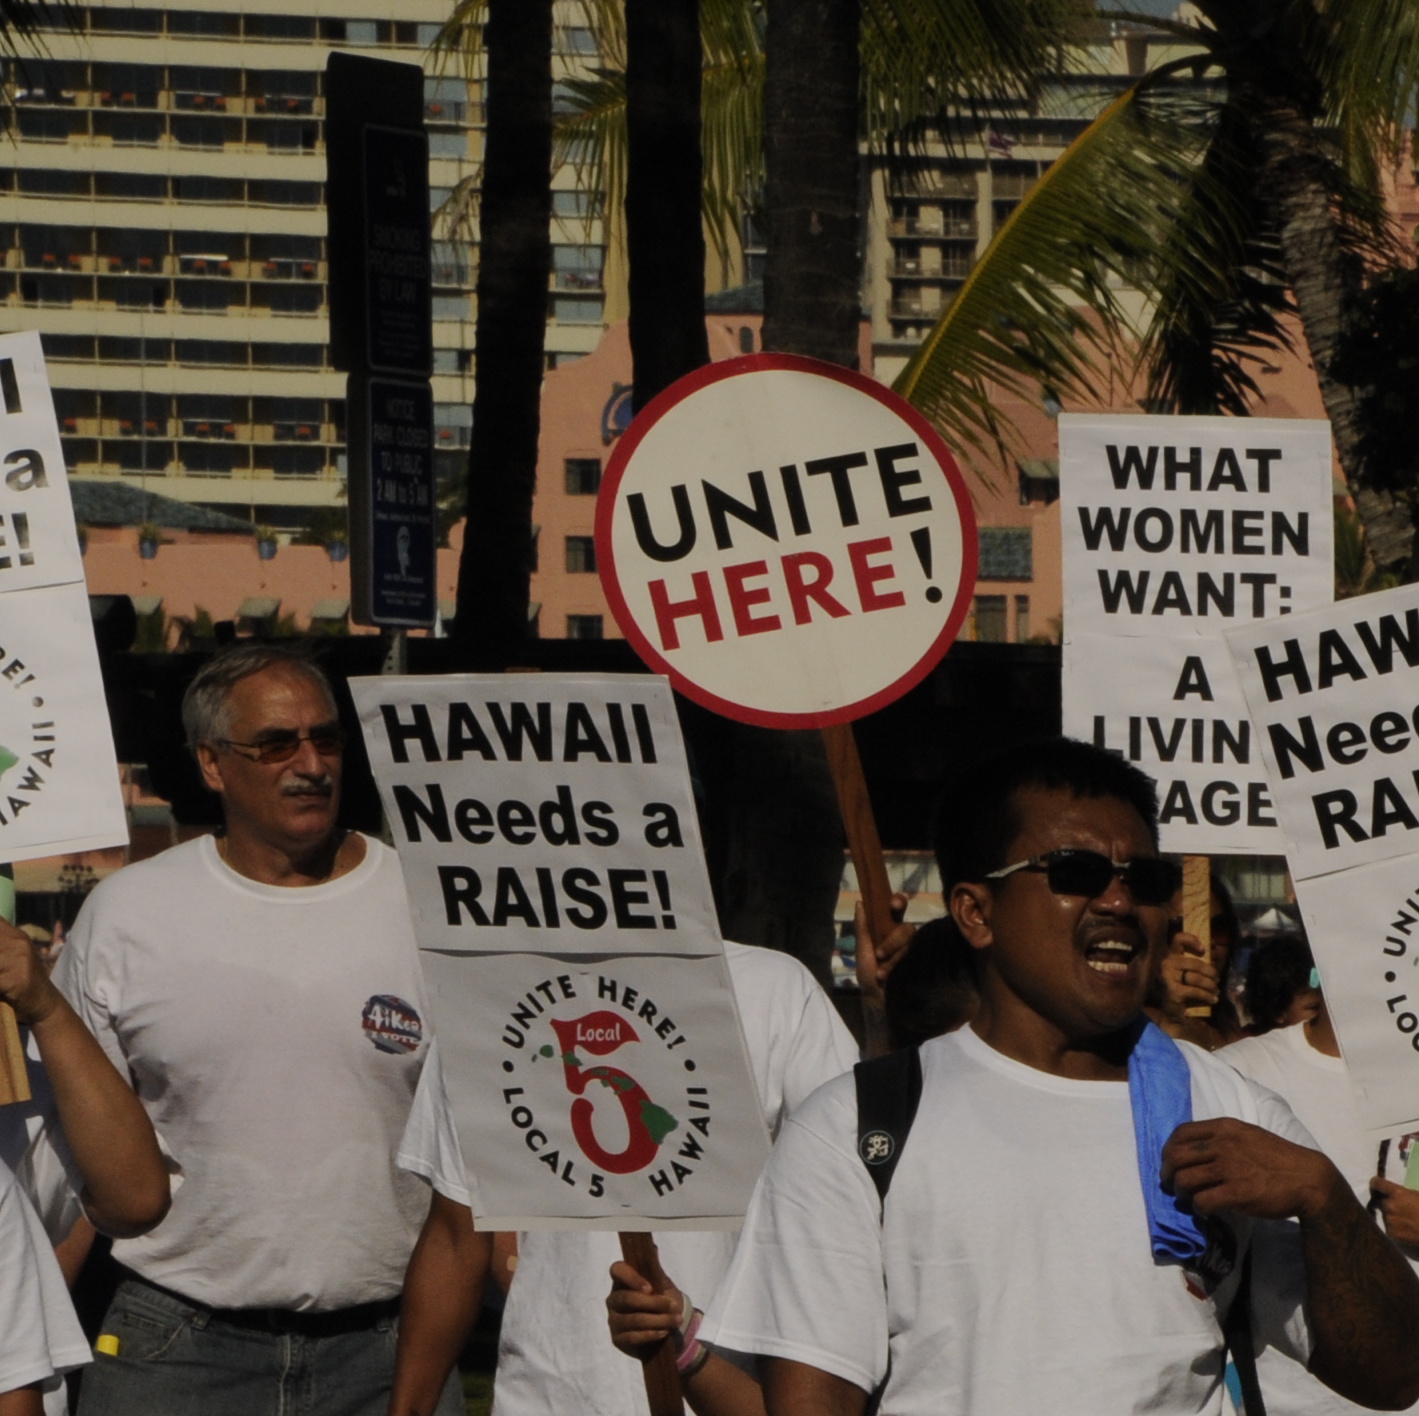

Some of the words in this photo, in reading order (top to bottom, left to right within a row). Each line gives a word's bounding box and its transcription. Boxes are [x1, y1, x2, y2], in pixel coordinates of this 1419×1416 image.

[373, 224, 421, 253] SMOKING
[369, 249, 427, 279] PROHIBITED
[395, 280, 417, 304] LAW
[373, 423, 394, 443] PARK
[397, 425, 430, 448] CLOSED
[5, 448, 49, 491] a
[381, 451, 393, 472] TO
[395, 453, 423, 476] PUBLIC
[1106, 445, 1282, 493] WHAT
[377, 480, 384, 500] 2
[384, 481, 398, 502] AM
[416, 485, 429, 506] AM
[627, 444, 932, 562] UNITE
[1078, 507, 1309, 556] WOMEN
[647, 527, 941, 650] HERE!
[1098, 569, 1291, 617] WANT:
[1173, 656, 1213, 701] A
[379, 702, 657, 763] HAWAII
[1093, 716, 1250, 764] LIVIN
[0, 721, 55, 826] AWAII
[392, 784, 619, 846] Needs
[643, 803, 684, 848] a
[1156, 779, 1278, 827] AGE
[437, 866, 676, 929] RAISE!
[503, 975, 576, 1058] UNITE
[598, 976, 685, 1049] HERE!
[575, 1022, 623, 1046] Local
[551, 1010, 660, 1175] 5
[503, 1088, 575, 1186] LOCAL
[589, 1174, 604, 1197] 5
[641, 1088, 710, 1196] HAWAII
